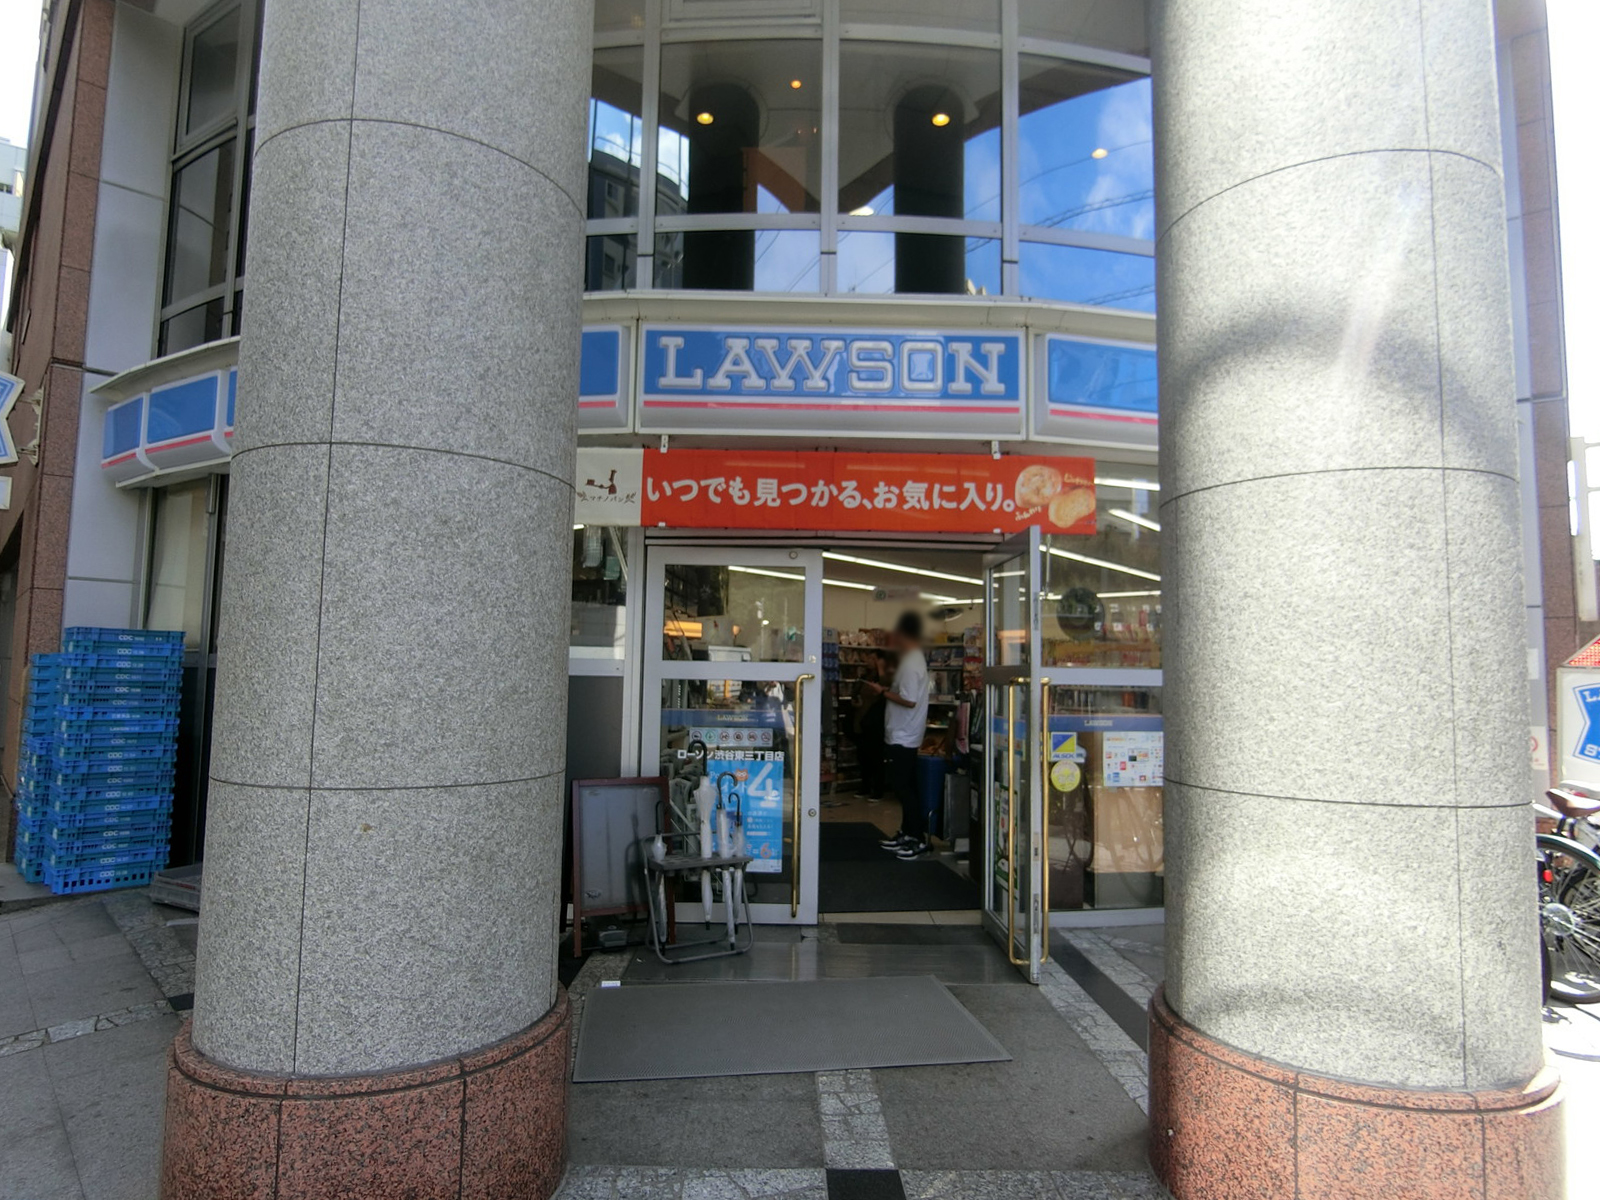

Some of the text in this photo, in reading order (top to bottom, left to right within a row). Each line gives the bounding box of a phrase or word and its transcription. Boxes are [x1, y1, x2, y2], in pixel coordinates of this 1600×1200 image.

[657, 336, 1006, 395] LAWSON
[589, 494, 624, 503] マチノパン
[646, 476, 1015, 512] いつでも見つかる、お気に入り。
[1583, 690, 1600, 702] L
[677, 750, 784, 762] ローソン渋谷東三丁目店
